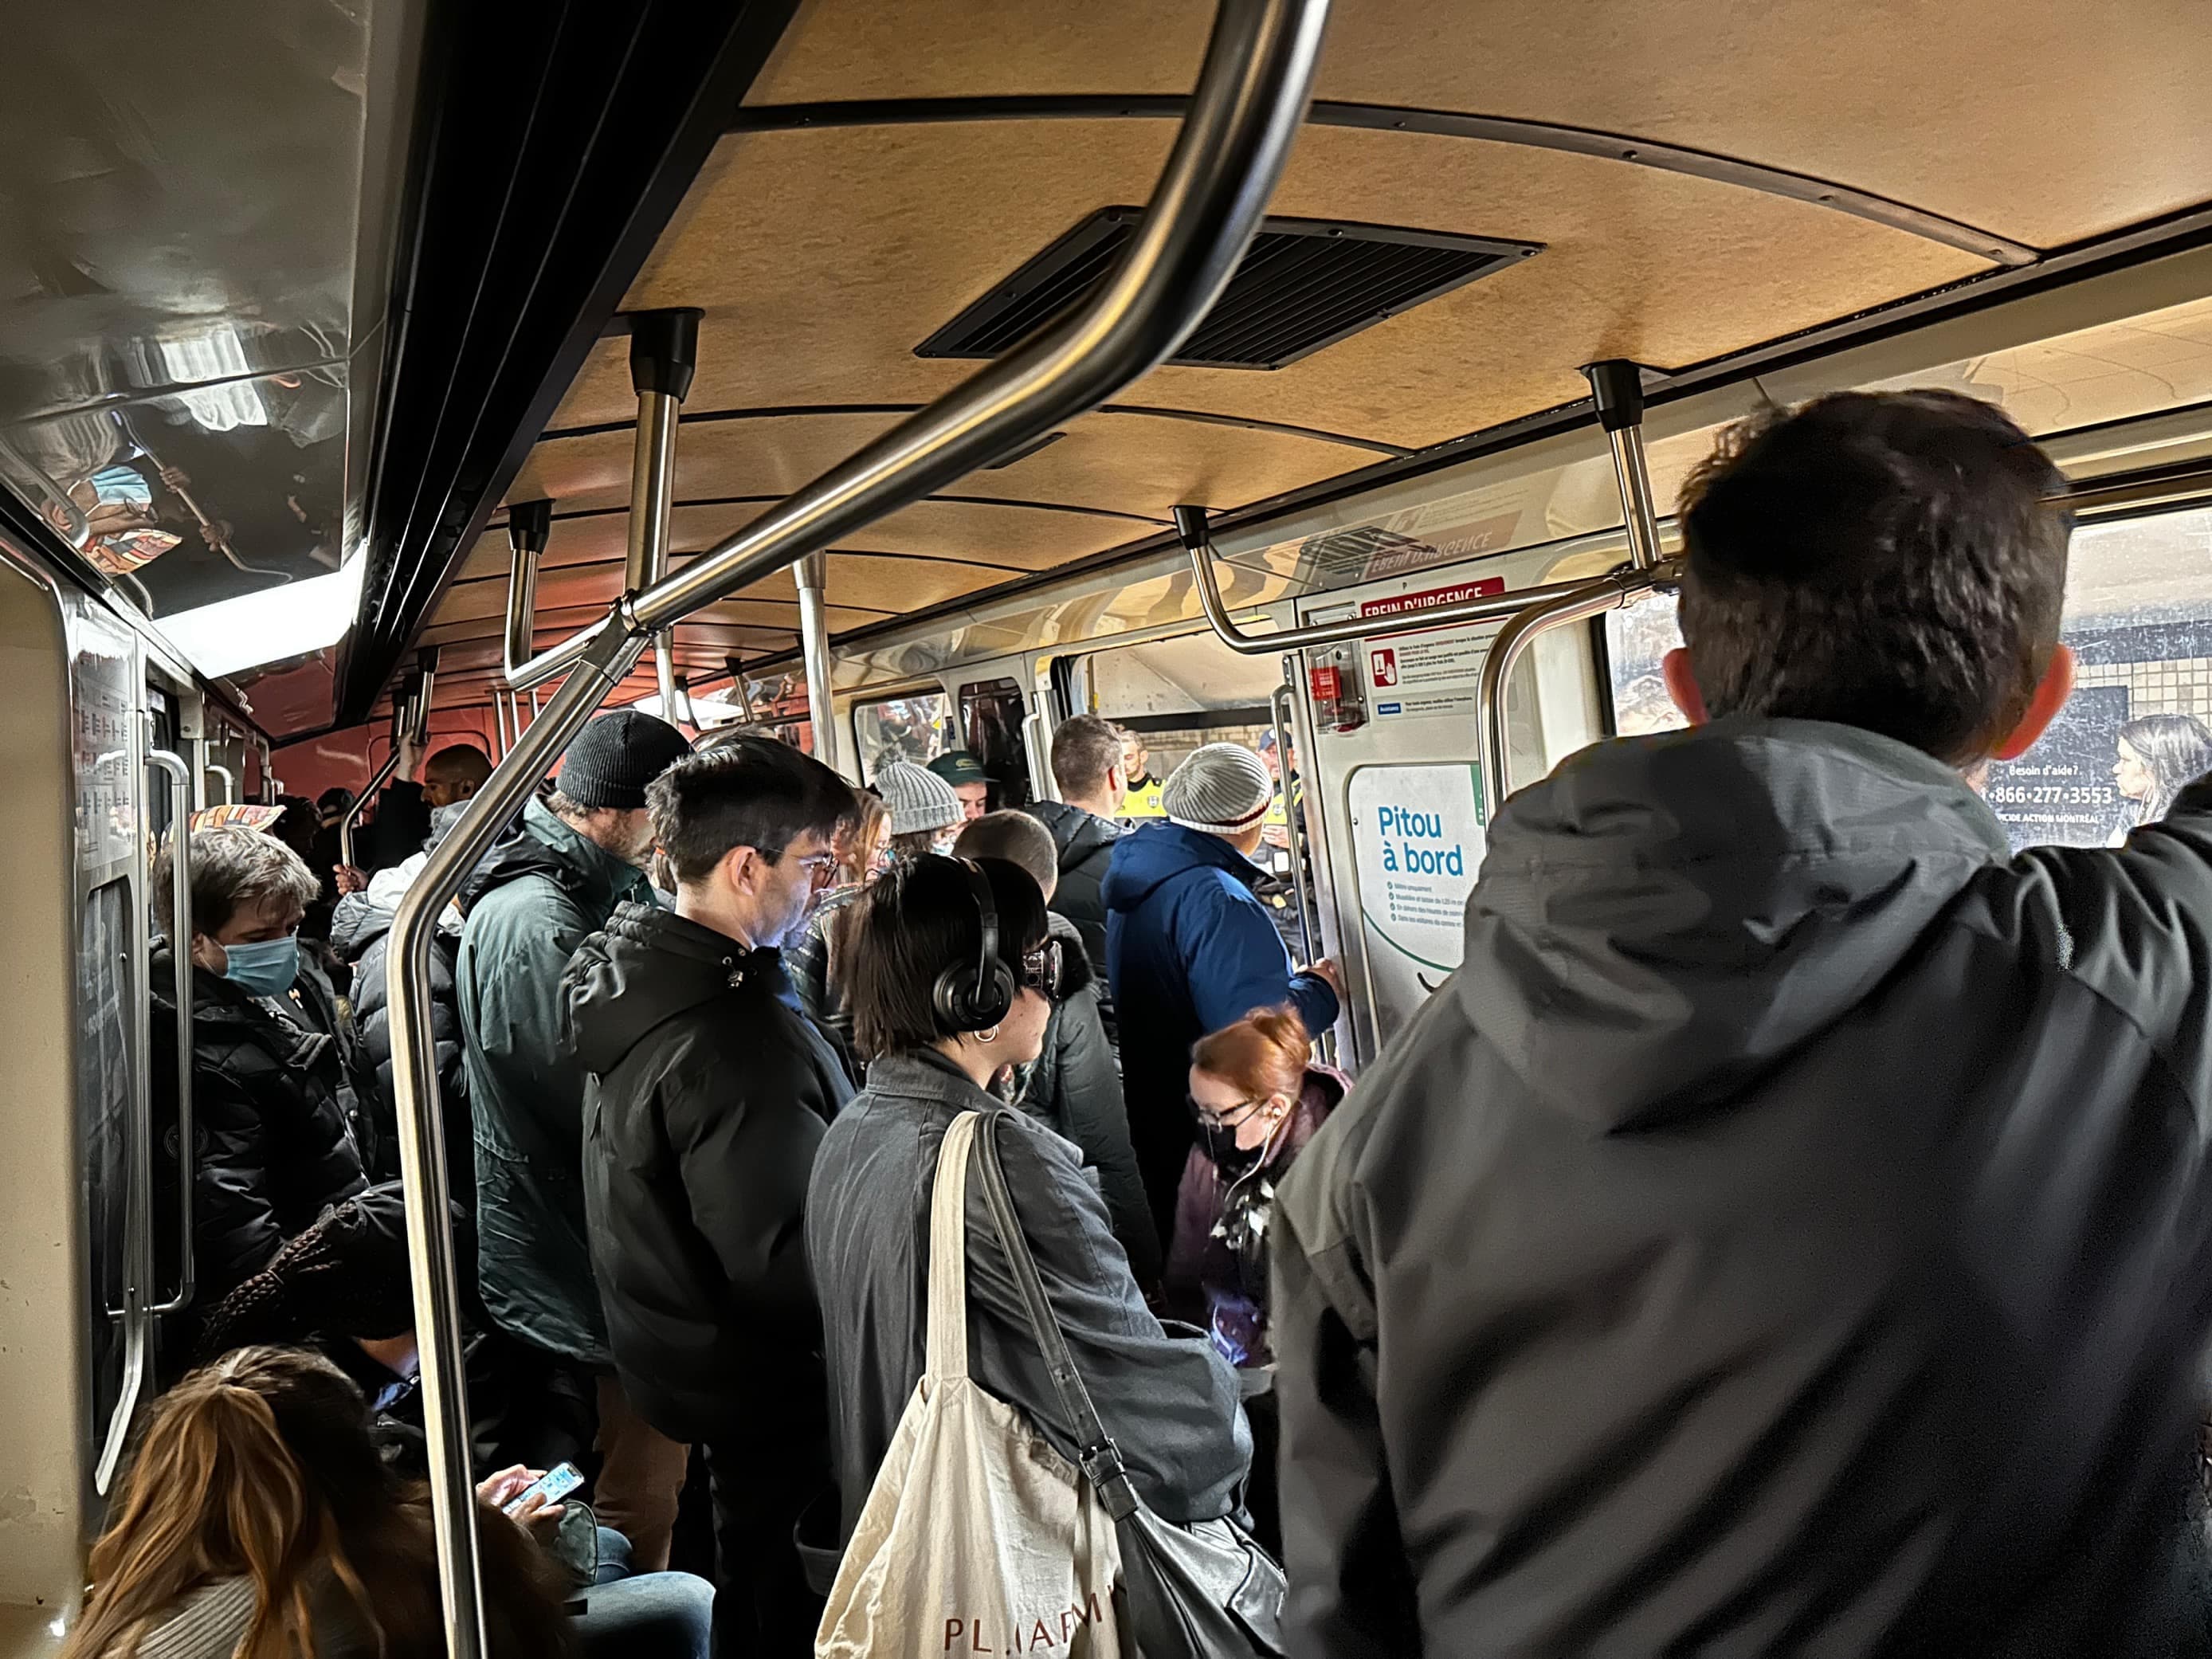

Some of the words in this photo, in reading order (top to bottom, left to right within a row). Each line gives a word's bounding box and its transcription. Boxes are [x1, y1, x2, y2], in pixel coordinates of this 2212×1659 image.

[2009, 764, 2041, 776] Besoin
[1377, 805, 1442, 838] Pitou
[2022, 813, 2055, 823] ACTION
[1382, 841, 1398, 872] à
[1403, 842, 1464, 877] bord
